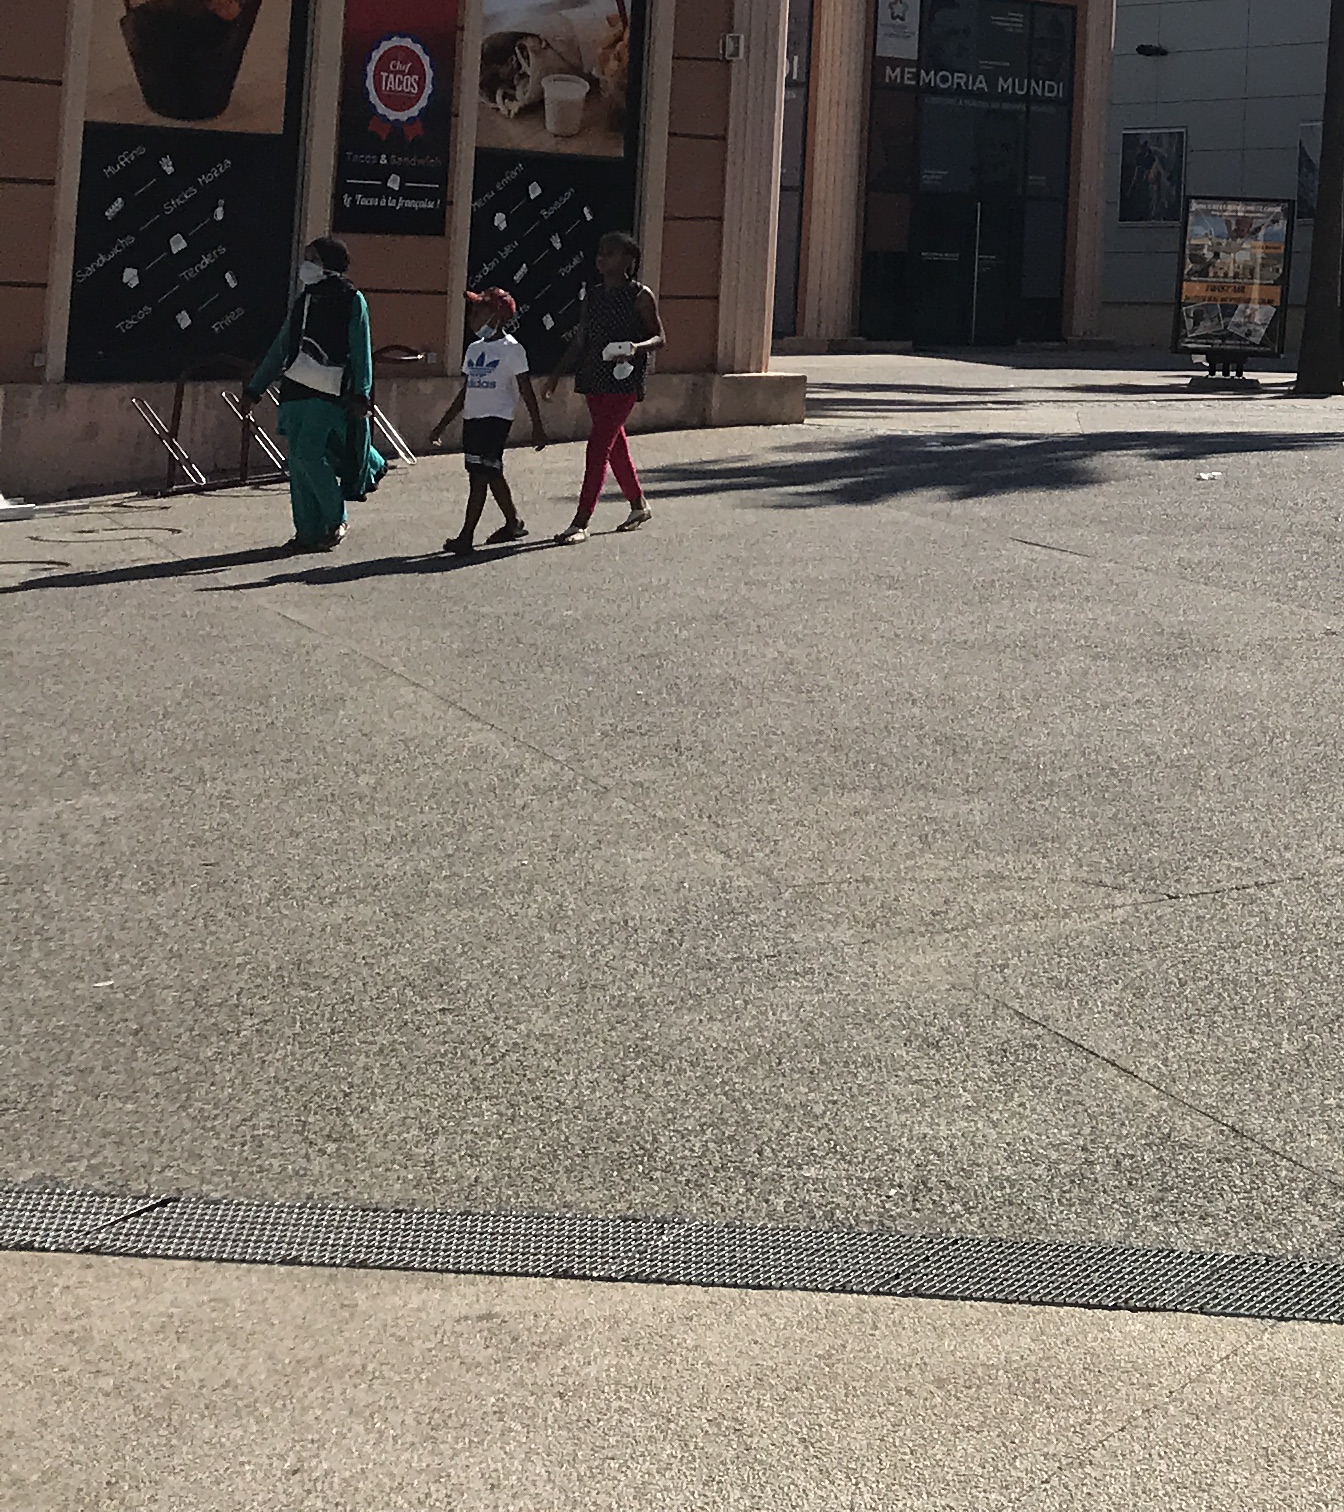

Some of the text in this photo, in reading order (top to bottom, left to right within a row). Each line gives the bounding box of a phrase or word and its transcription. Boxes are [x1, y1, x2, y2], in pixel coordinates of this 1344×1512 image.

[389, 60, 412, 72] Chef
[381, 72, 419, 93] TACOS
[885, 66, 1064, 98] MEMORIA MUNDI
[103, 145, 147, 179] Muffins
[197, 159, 232, 186] Mozza
[345, 151, 442, 167] Tacos & Sandwich
[471, 163, 526, 212] Menu enfant
[540, 187, 576, 220] Boisson
[75, 235, 136, 283] Sandwichs
[179, 245, 227, 281] Tenders
[498, 240, 520, 259] bleu
[116, 305, 153, 334] Tacos
[211, 307, 246, 334] Frites
